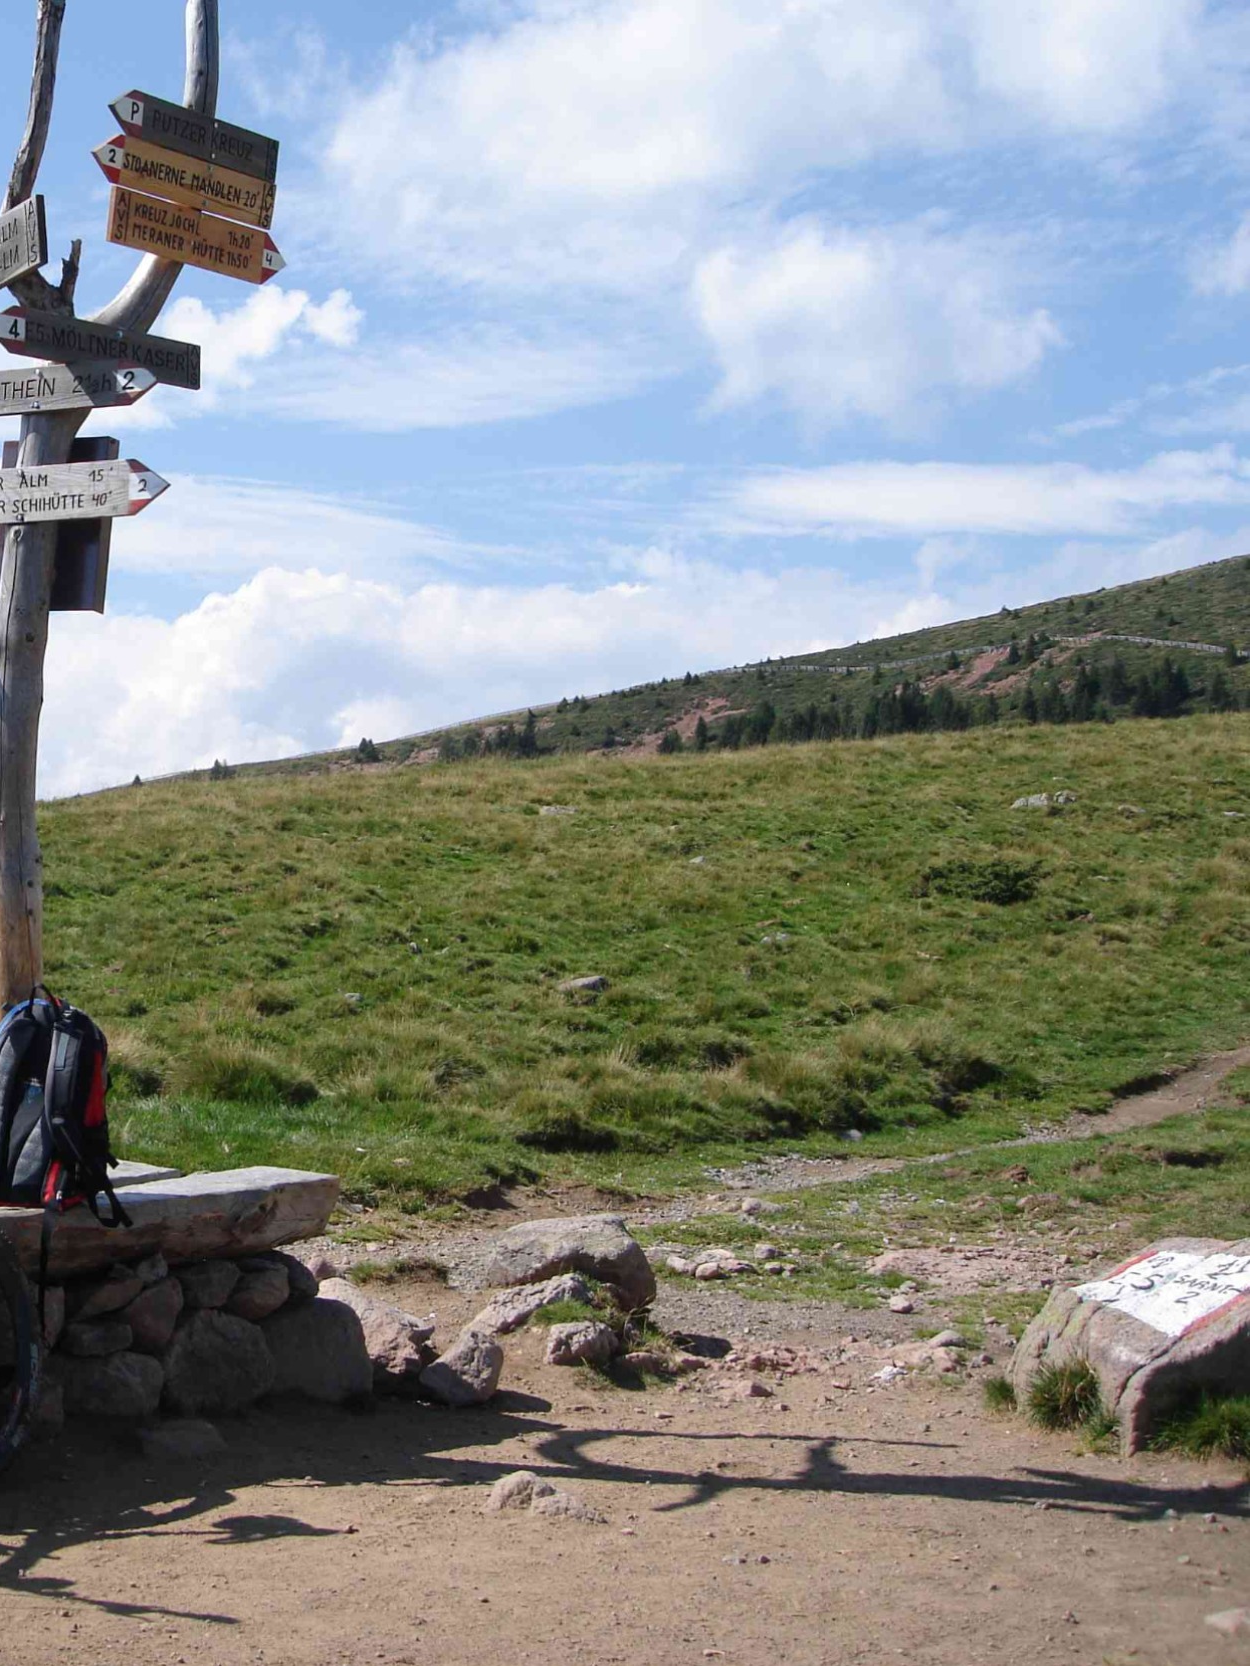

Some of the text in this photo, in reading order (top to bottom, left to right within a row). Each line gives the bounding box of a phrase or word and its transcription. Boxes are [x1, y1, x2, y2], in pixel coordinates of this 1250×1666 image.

[131, 102, 140, 121] P
[152, 109, 207, 144] PUTZER
[210, 130, 253, 161] KREUZ
[108, 149, 116, 163] 2
[123, 153, 186, 186] STOANERNE
[132, 222, 185, 251] MERANER
[191, 238, 225, 263] HÜTTE
[266, 251, 273, 266] 4
[9, 318, 20, 338] 4
[52, 324, 128, 359] MÖLTNER
[132, 344, 185, 372] KASER
[122, 371, 135, 390] 2
[19, 471, 48, 489] ALM
[137, 479, 147, 492] 2
[12, 492, 84, 514] SCHIHÜTTE
